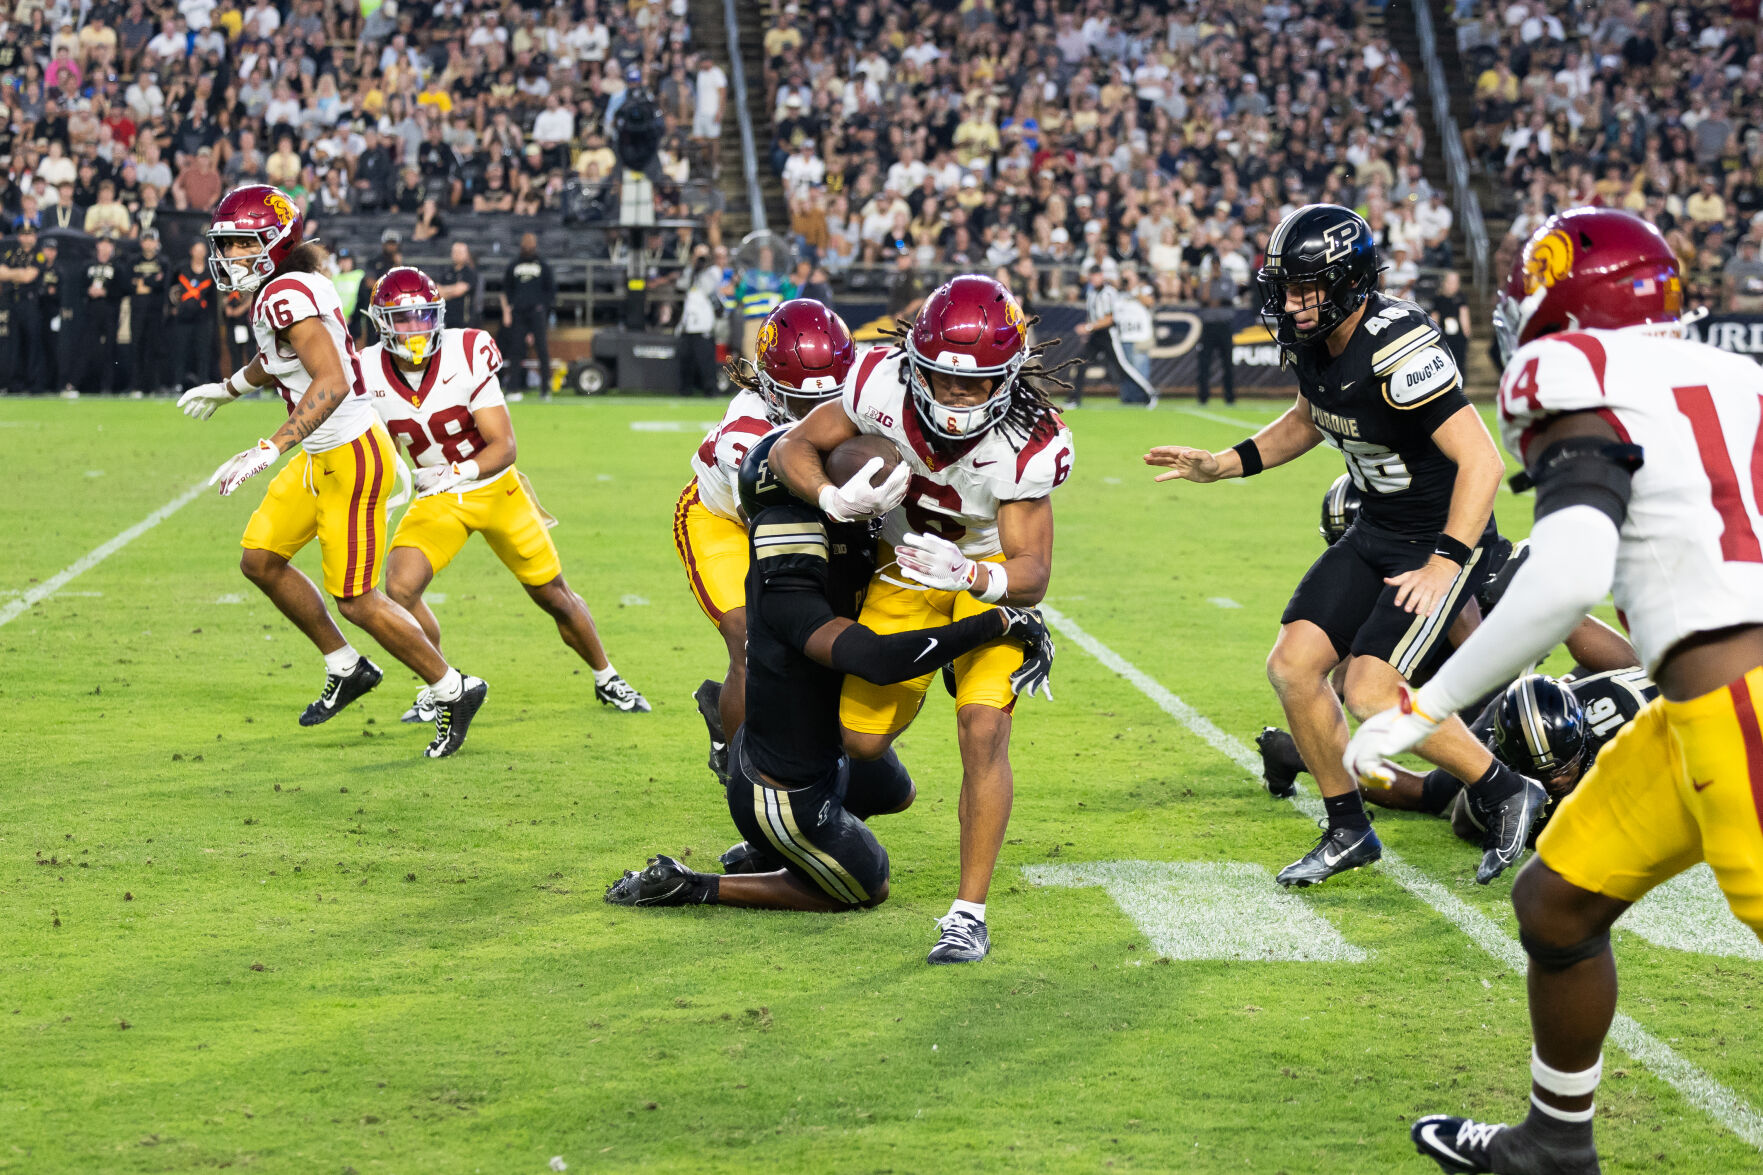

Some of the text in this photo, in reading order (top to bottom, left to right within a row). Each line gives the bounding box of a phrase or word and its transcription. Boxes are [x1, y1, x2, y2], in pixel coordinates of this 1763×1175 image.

[1322, 219, 1361, 264] P
[387, 404, 489, 470] 28
[1310, 401, 1361, 438] PURDUE
[235, 461, 269, 487] TROJANS
[1052, 447, 1071, 488] 6
[1671, 385, 1763, 564] 1
[901, 472, 967, 543] 6
